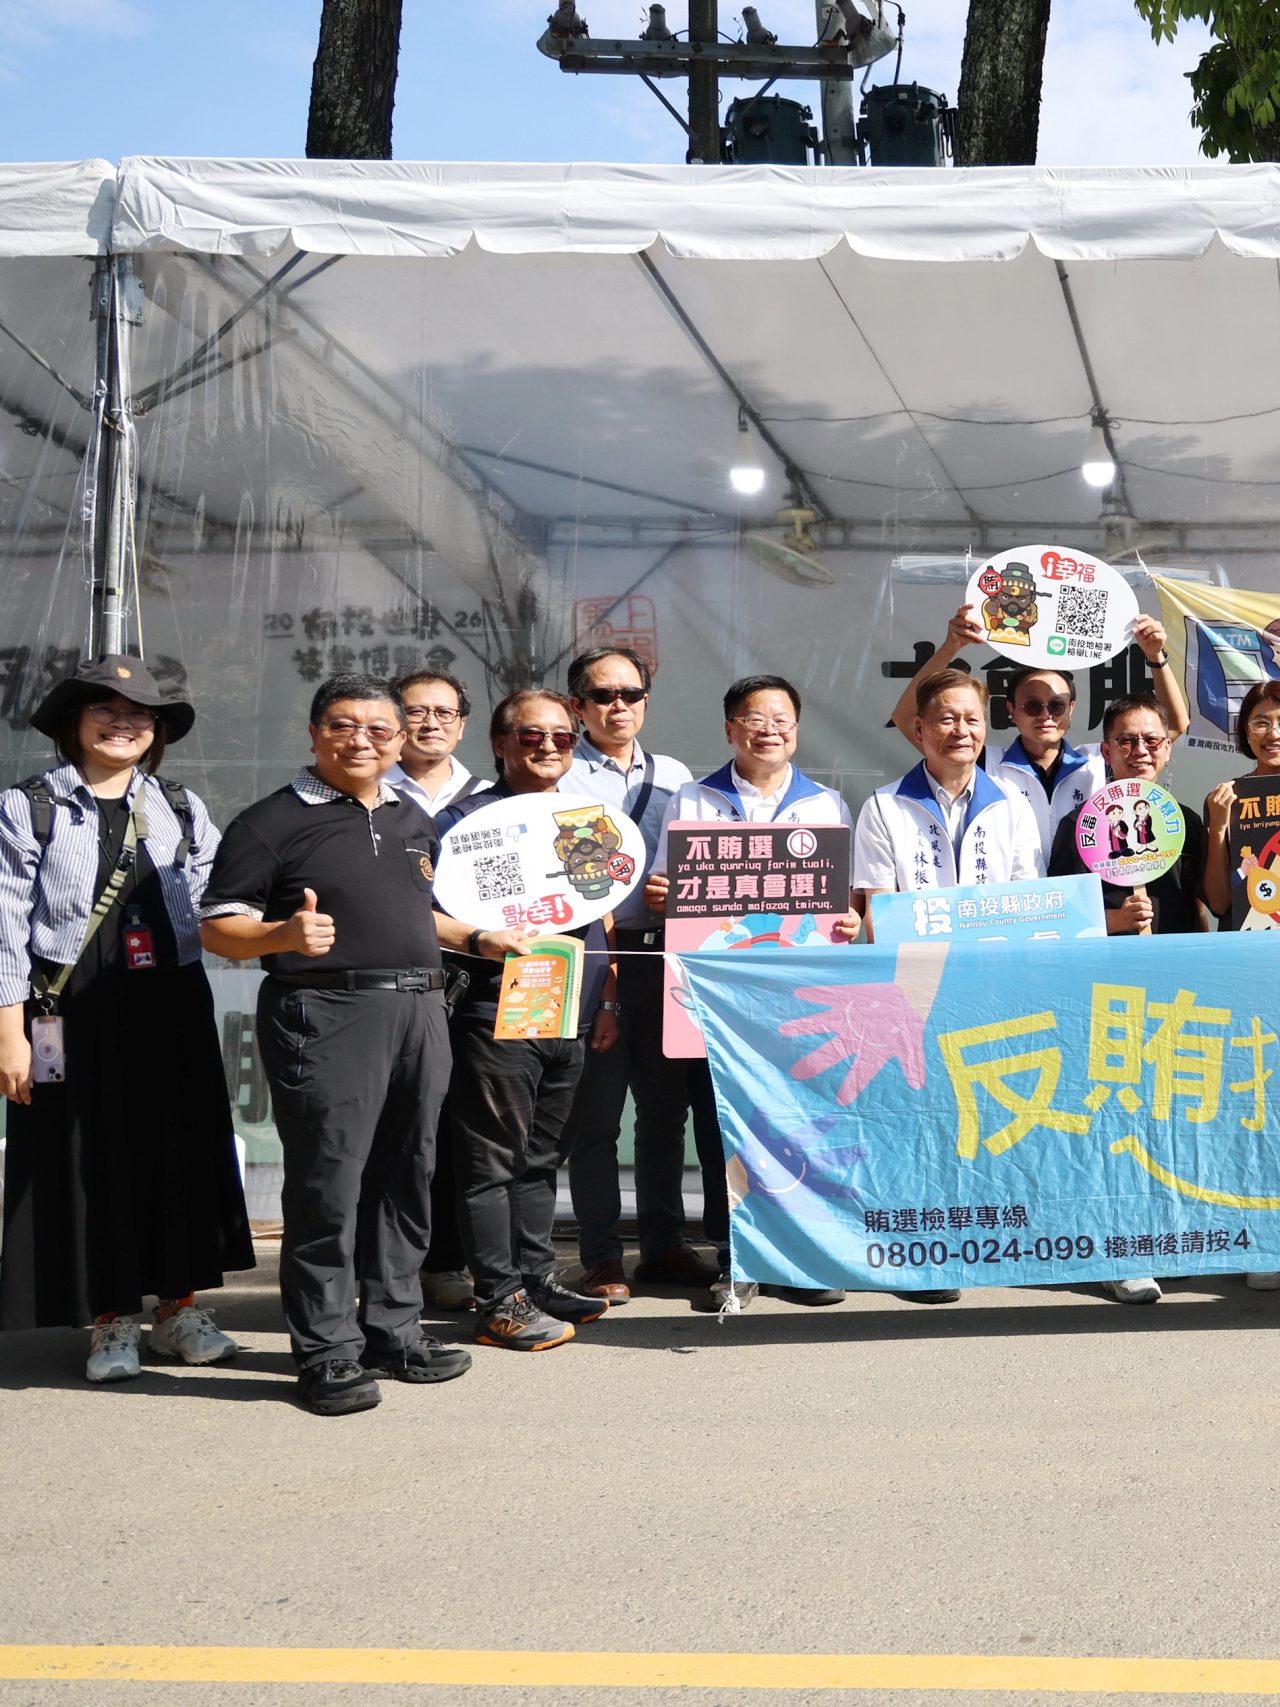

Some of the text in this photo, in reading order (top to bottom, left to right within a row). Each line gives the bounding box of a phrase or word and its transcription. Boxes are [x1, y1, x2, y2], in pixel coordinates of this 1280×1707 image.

[454, 610, 482, 629] 26
[1068, 638, 1112, 652] 南投地檢署
[1092, 782, 1142, 812] 反賄選
[1146, 787, 1181, 834] 反暴力
[1080, 814, 1098, 848] 反毒
[685, 834, 773, 861] 不賄選
[677, 863, 690, 873] ya
[695, 861, 715, 871] uka
[767, 860, 797, 871] fariw
[676, 900, 833, 914] amaqa sunda mafazaq tmiruq.
[956, 890, 1065, 919] 南投縣政府
[959, 911, 1067, 930] Nantou County Government
[863, 1203, 1030, 1234] 賄選檢舉專線
[866, 1227, 1252, 1270] 0800-024-099 撥通後請按4
